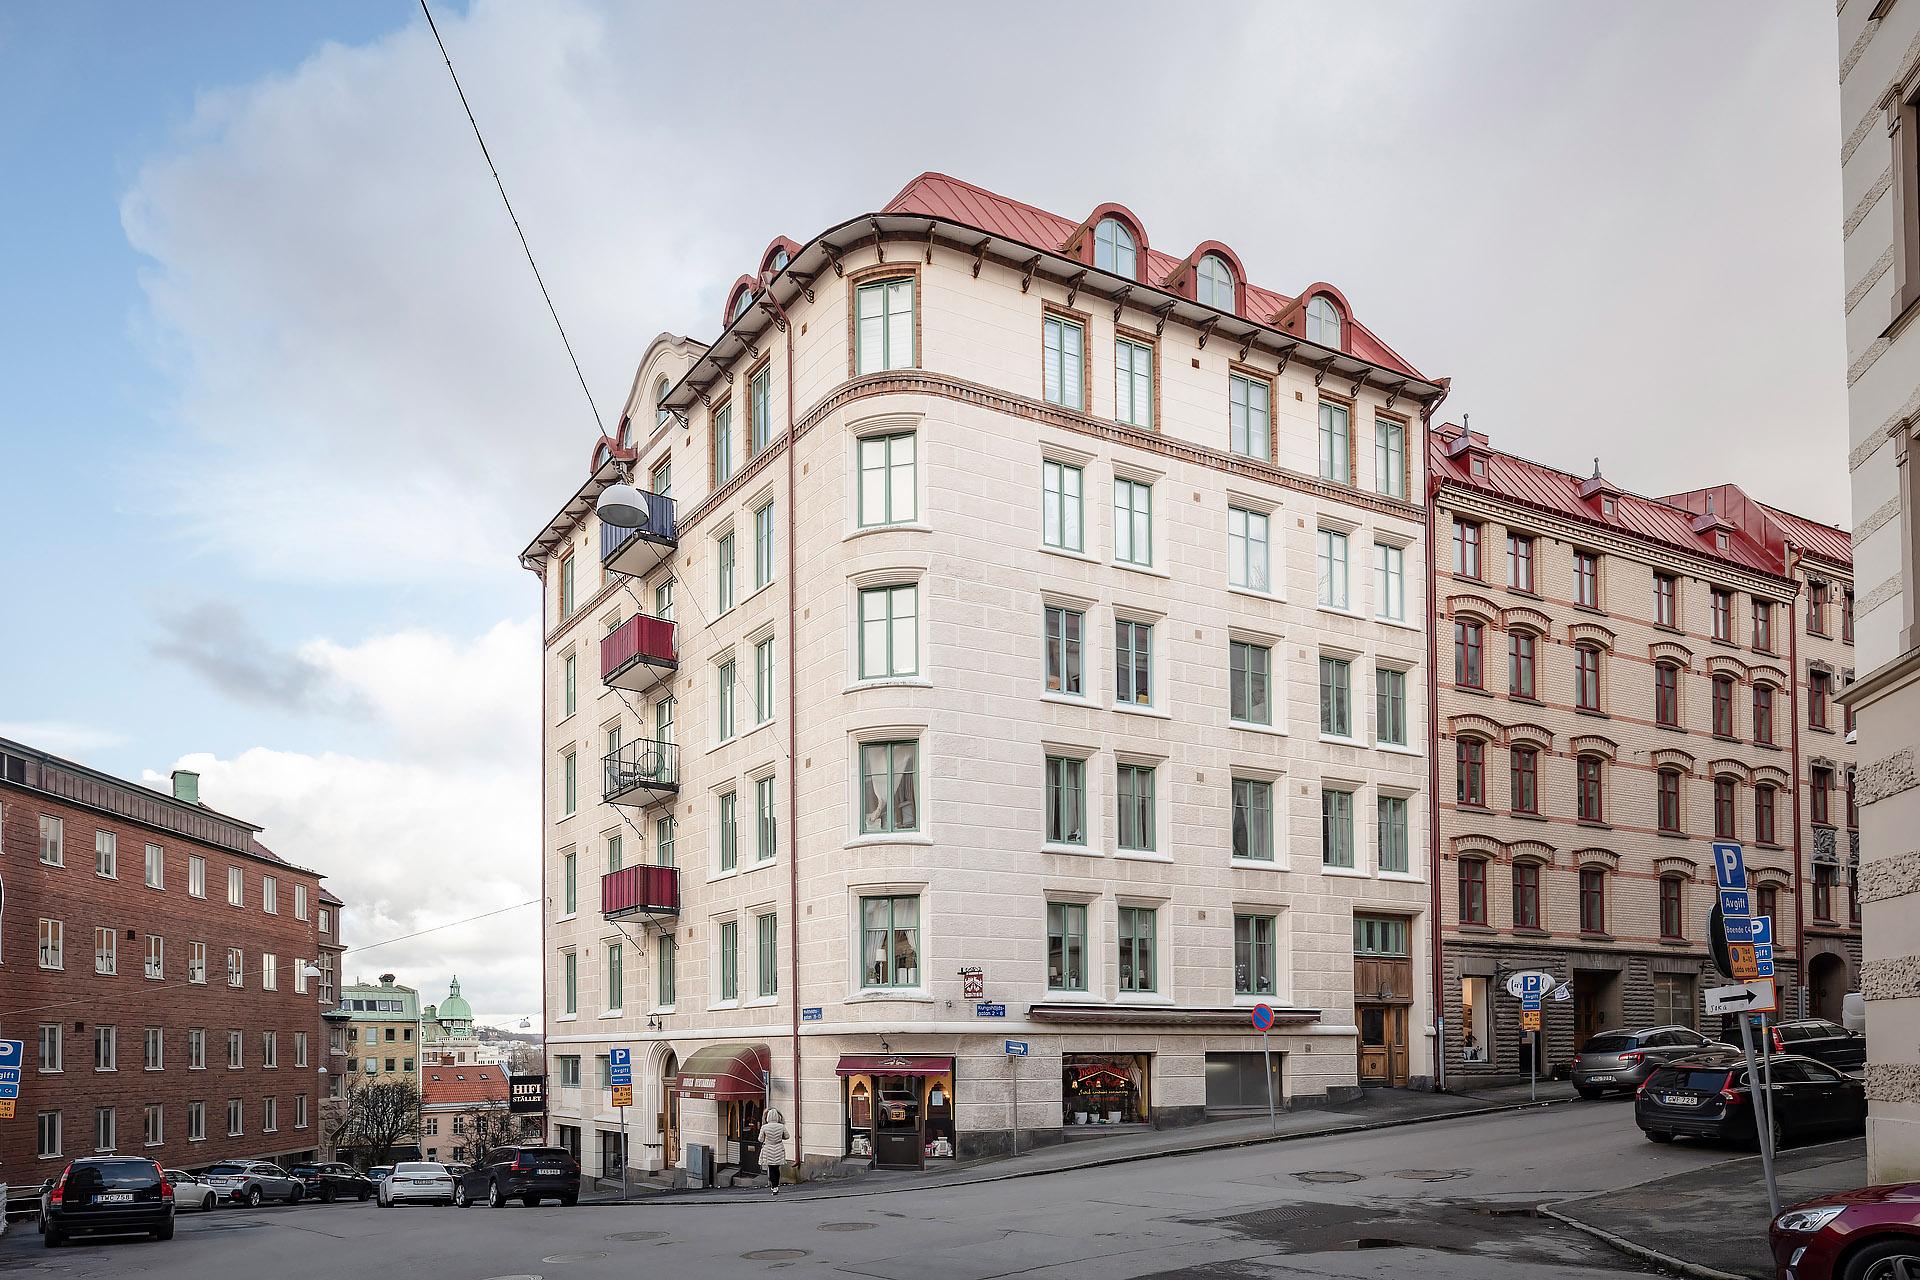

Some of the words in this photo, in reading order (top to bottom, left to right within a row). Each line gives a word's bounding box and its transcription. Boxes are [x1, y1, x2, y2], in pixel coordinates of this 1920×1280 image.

[1721, 848, 1738, 884] P
[1725, 897, 1746, 911] Avgift
[1726, 925, 1744, 934] Boende
[1745, 926, 1752, 934] C4
[1755, 949, 1768, 958] gift
[1527, 976, 1537, 991] P
[615, 1050, 626, 1064] P
[0, 1071, 15, 1080] gift
[512, 1084, 542, 1095] HIFI
